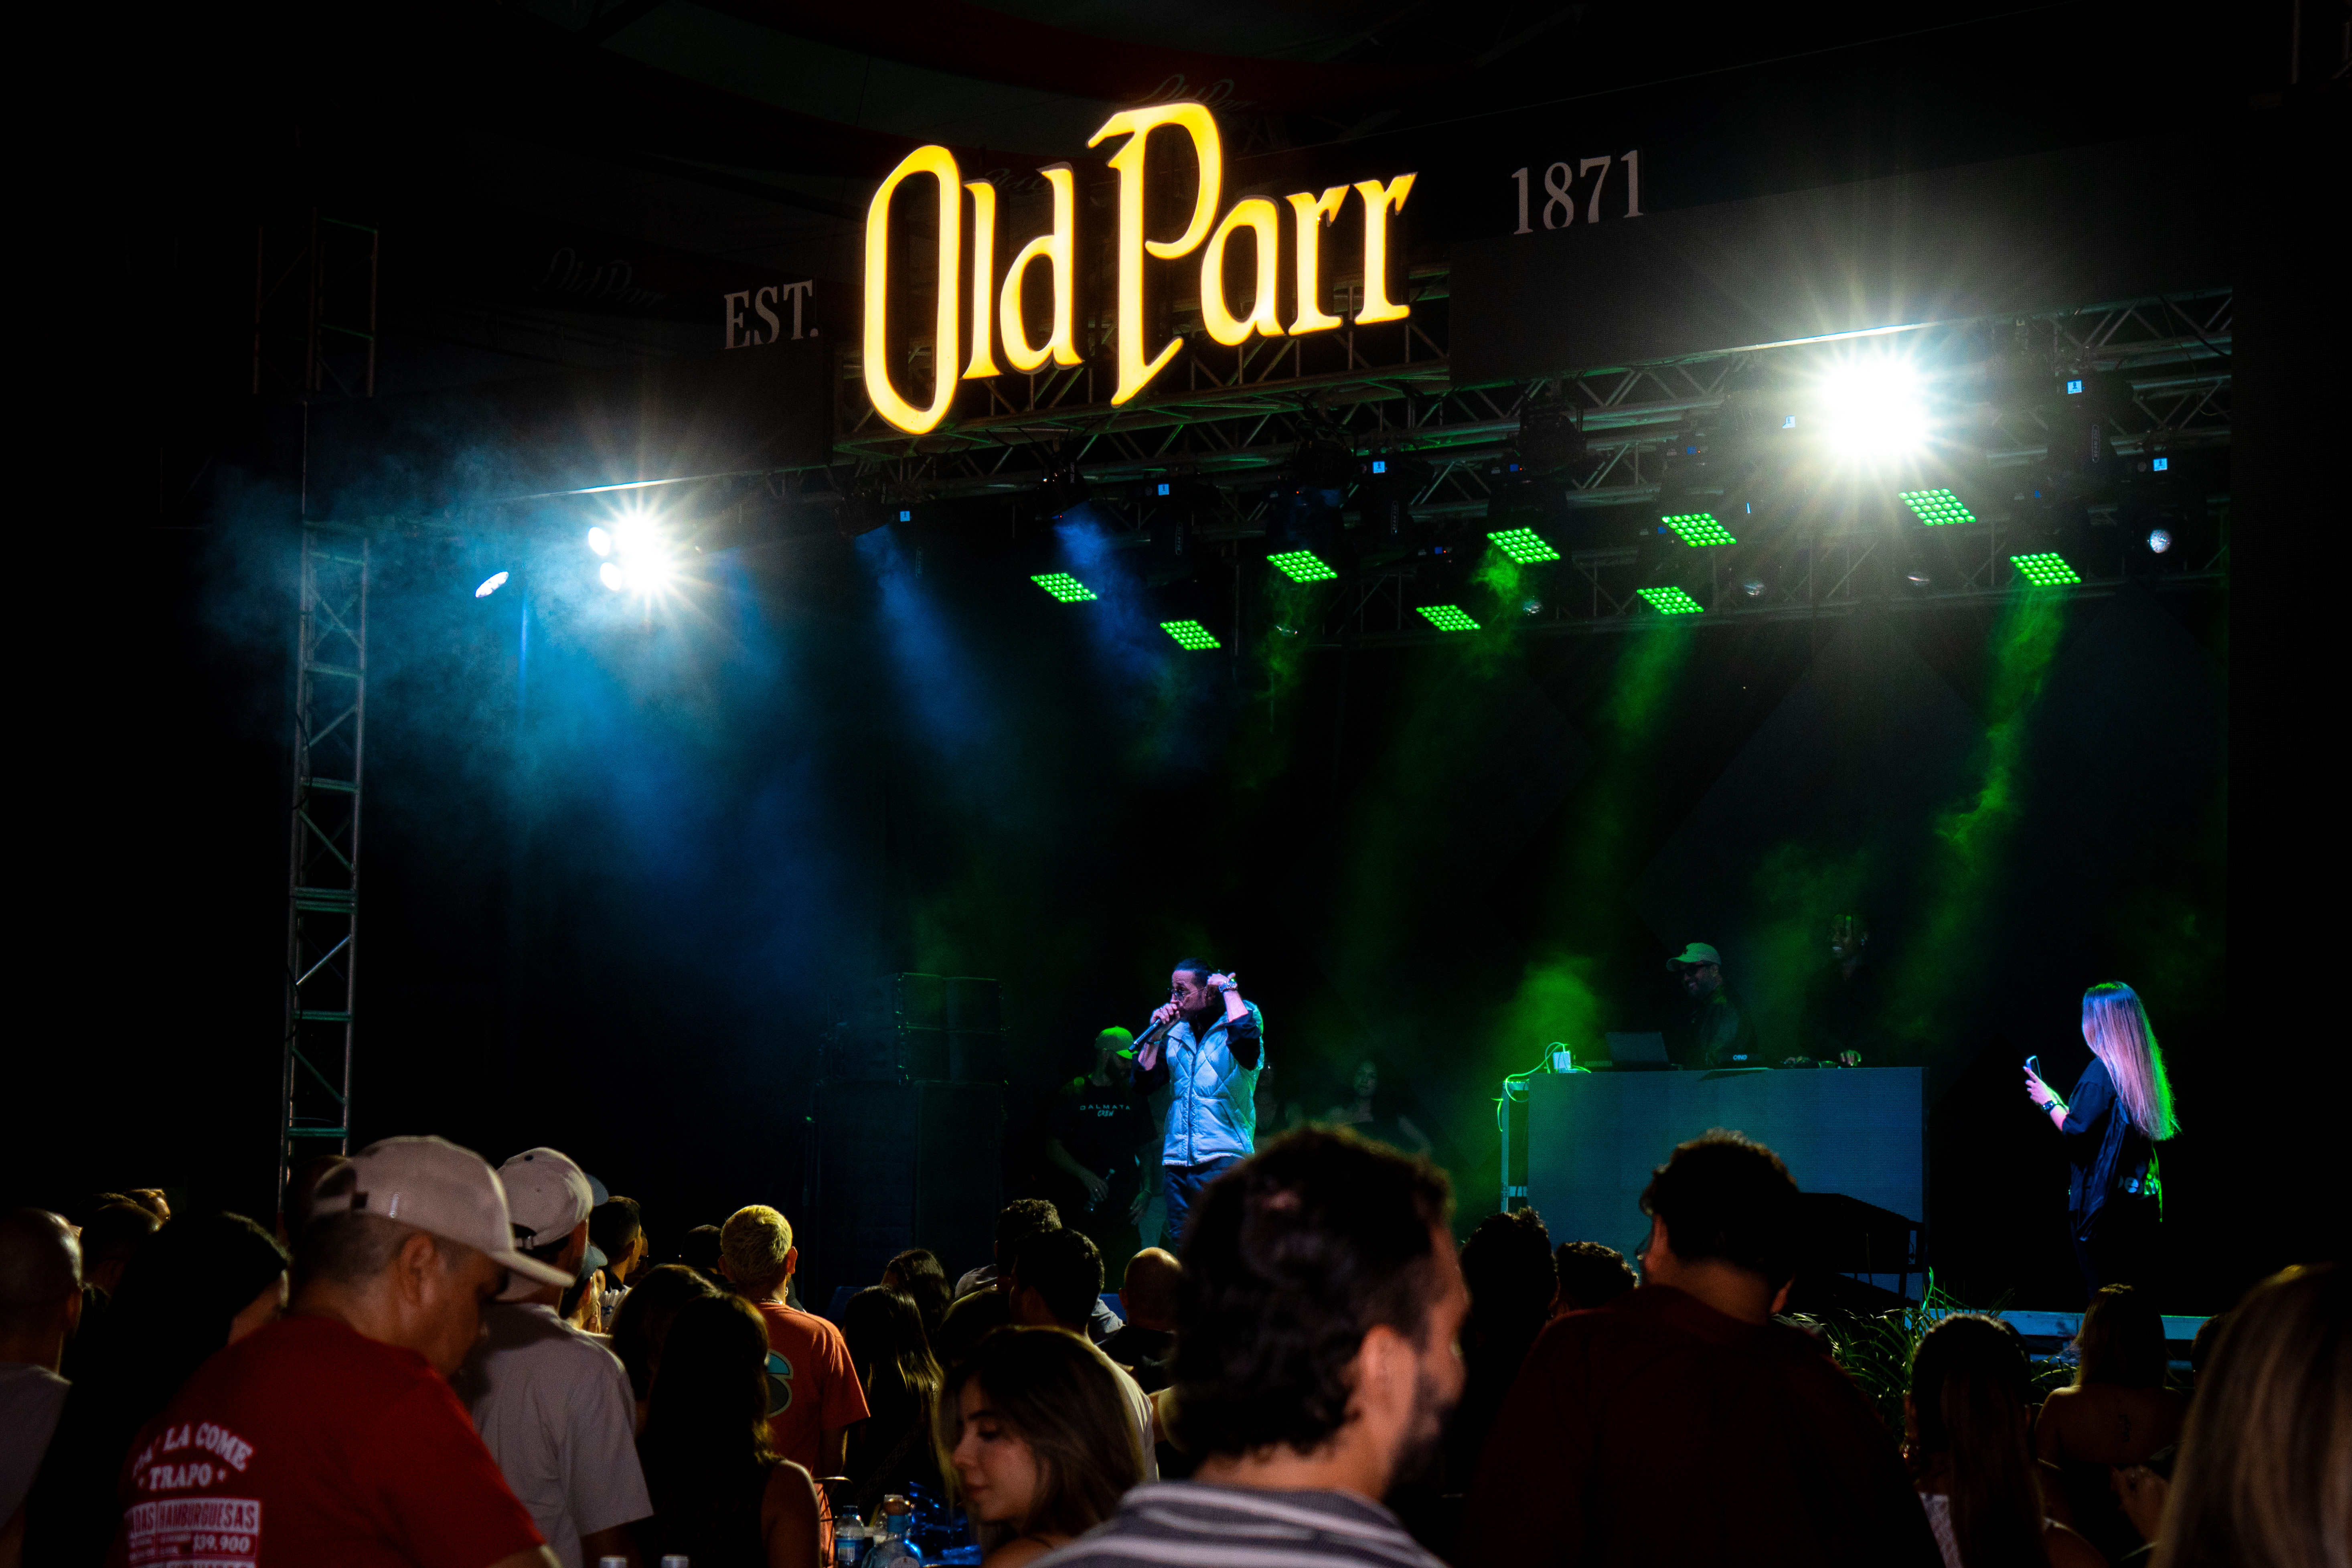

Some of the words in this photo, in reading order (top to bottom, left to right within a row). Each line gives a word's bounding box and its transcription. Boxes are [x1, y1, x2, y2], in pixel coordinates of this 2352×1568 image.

[1511, 150, 1644, 234] 1871
[863, 145, 1083, 434] Old
[1086, 99, 1418, 407] Parr
[724, 279, 819, 349] EST.
[149, 1463, 213, 1491] TRAPO
[162, 1423, 190, 1452] LA
[195, 1422, 253, 1472] COME
[160, 1503, 255, 1530] HAMBURGUESAS
